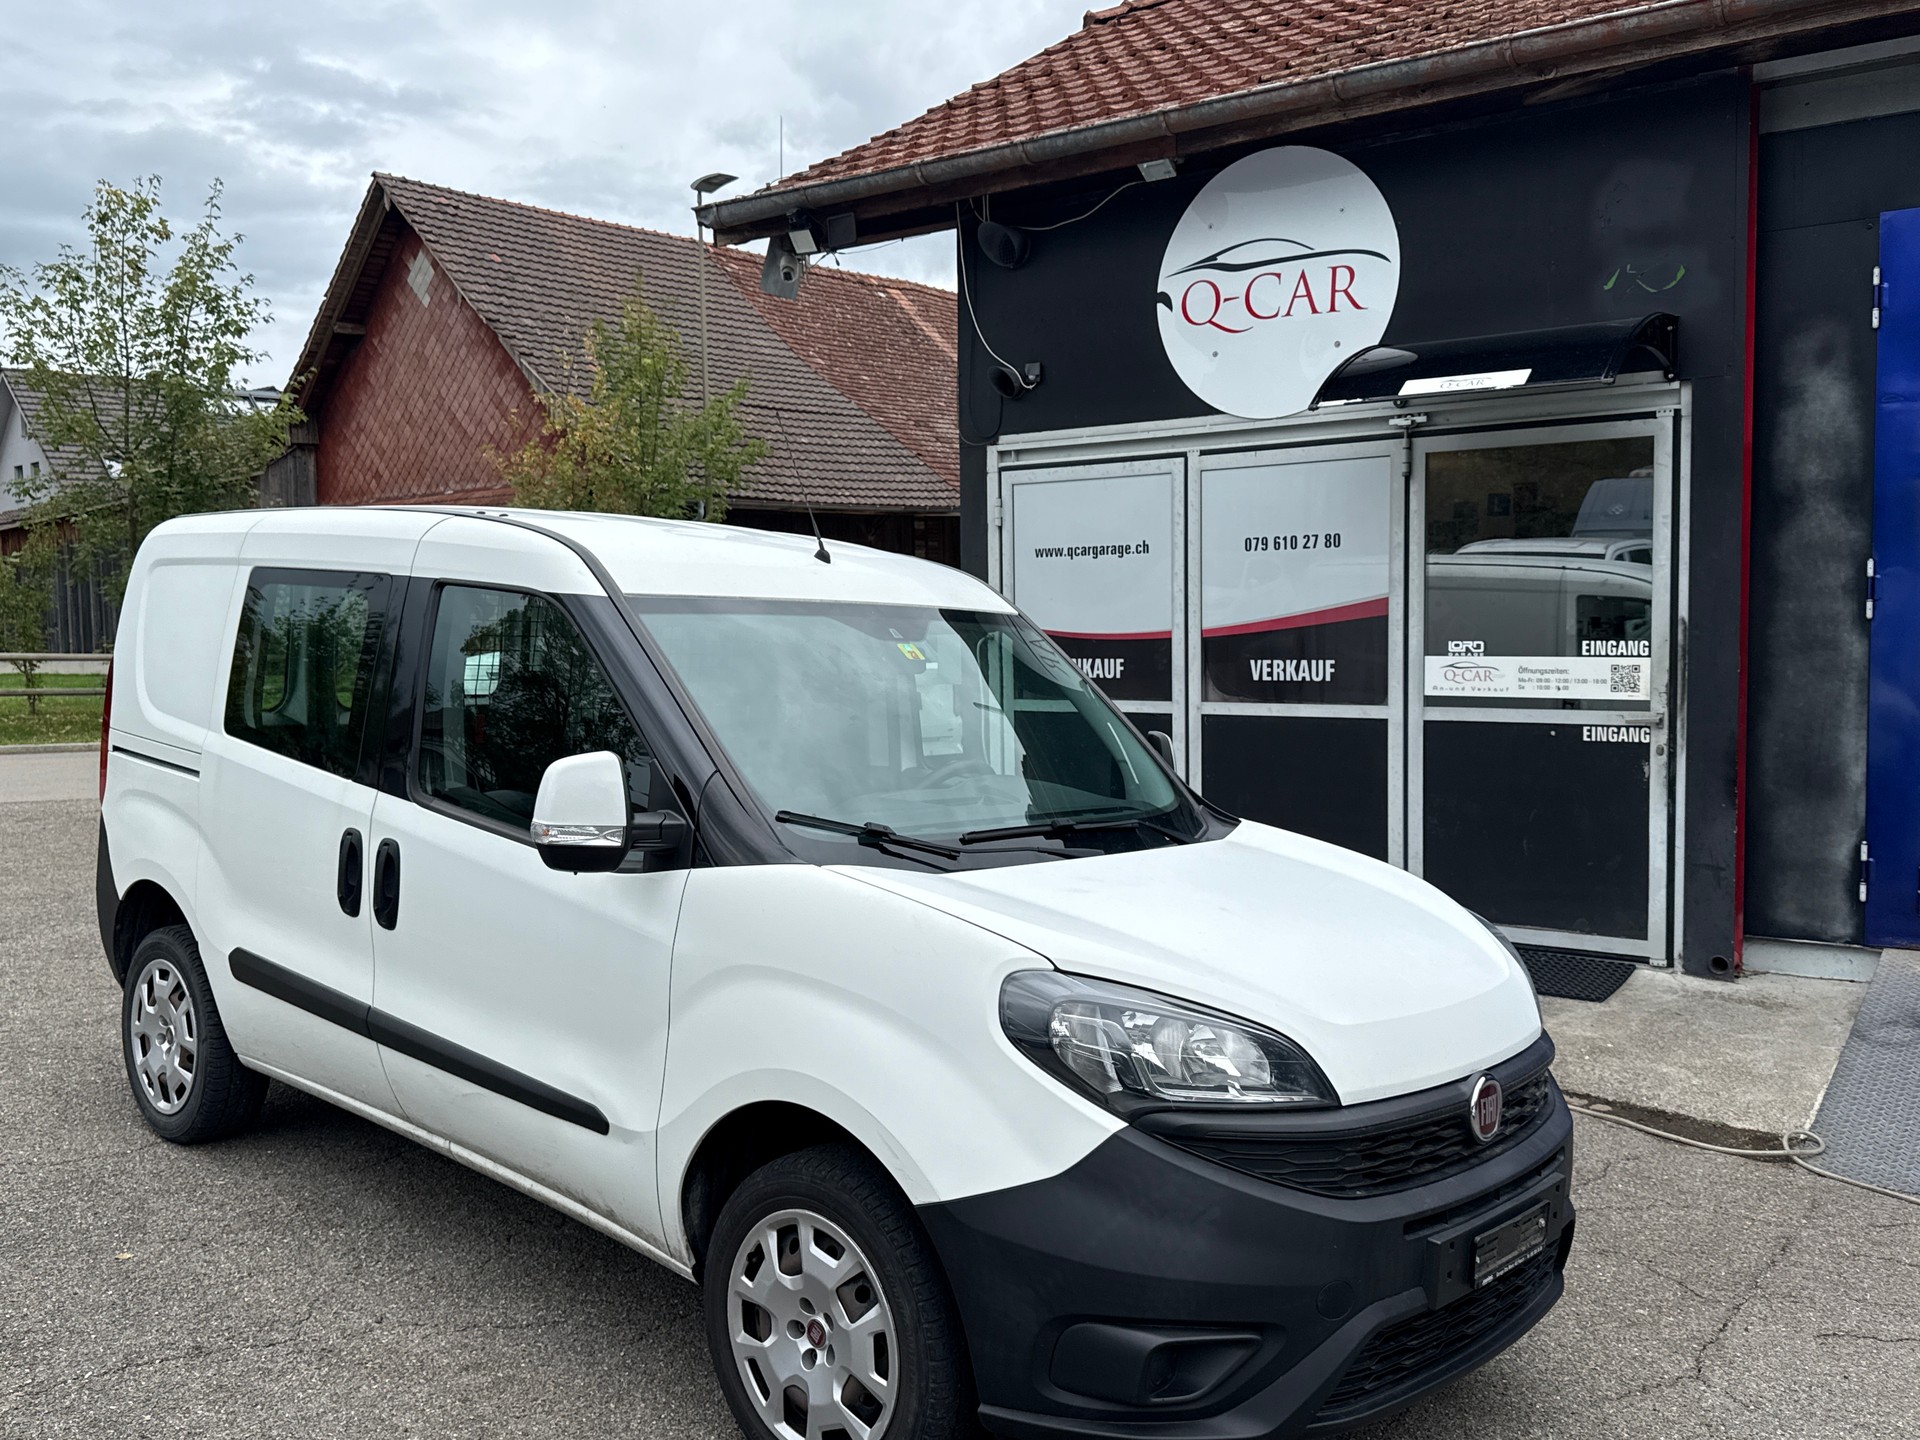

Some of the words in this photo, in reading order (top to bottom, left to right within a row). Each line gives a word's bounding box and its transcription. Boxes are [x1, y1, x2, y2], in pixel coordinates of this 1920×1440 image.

[1181, 265, 1368, 334] Q-CAR
[1034, 539, 1150, 560] www.qcargarage.ch
[1244, 535, 1269, 552] 079
[1273, 534, 1299, 551] 610
[1303, 533, 1319, 550] 27
[1324, 532, 1342, 549] 80
[1582, 640, 1650, 656] EINGANG
[1250, 658, 1336, 682] VERKAUF
[1444, 669, 1494, 684] Q-CAR
[1518, 666, 1570, 676] Öffnungszeiten:
[1582, 726, 1650, 743] EINGANG
[1480, 1093, 1497, 1126] FIAT
